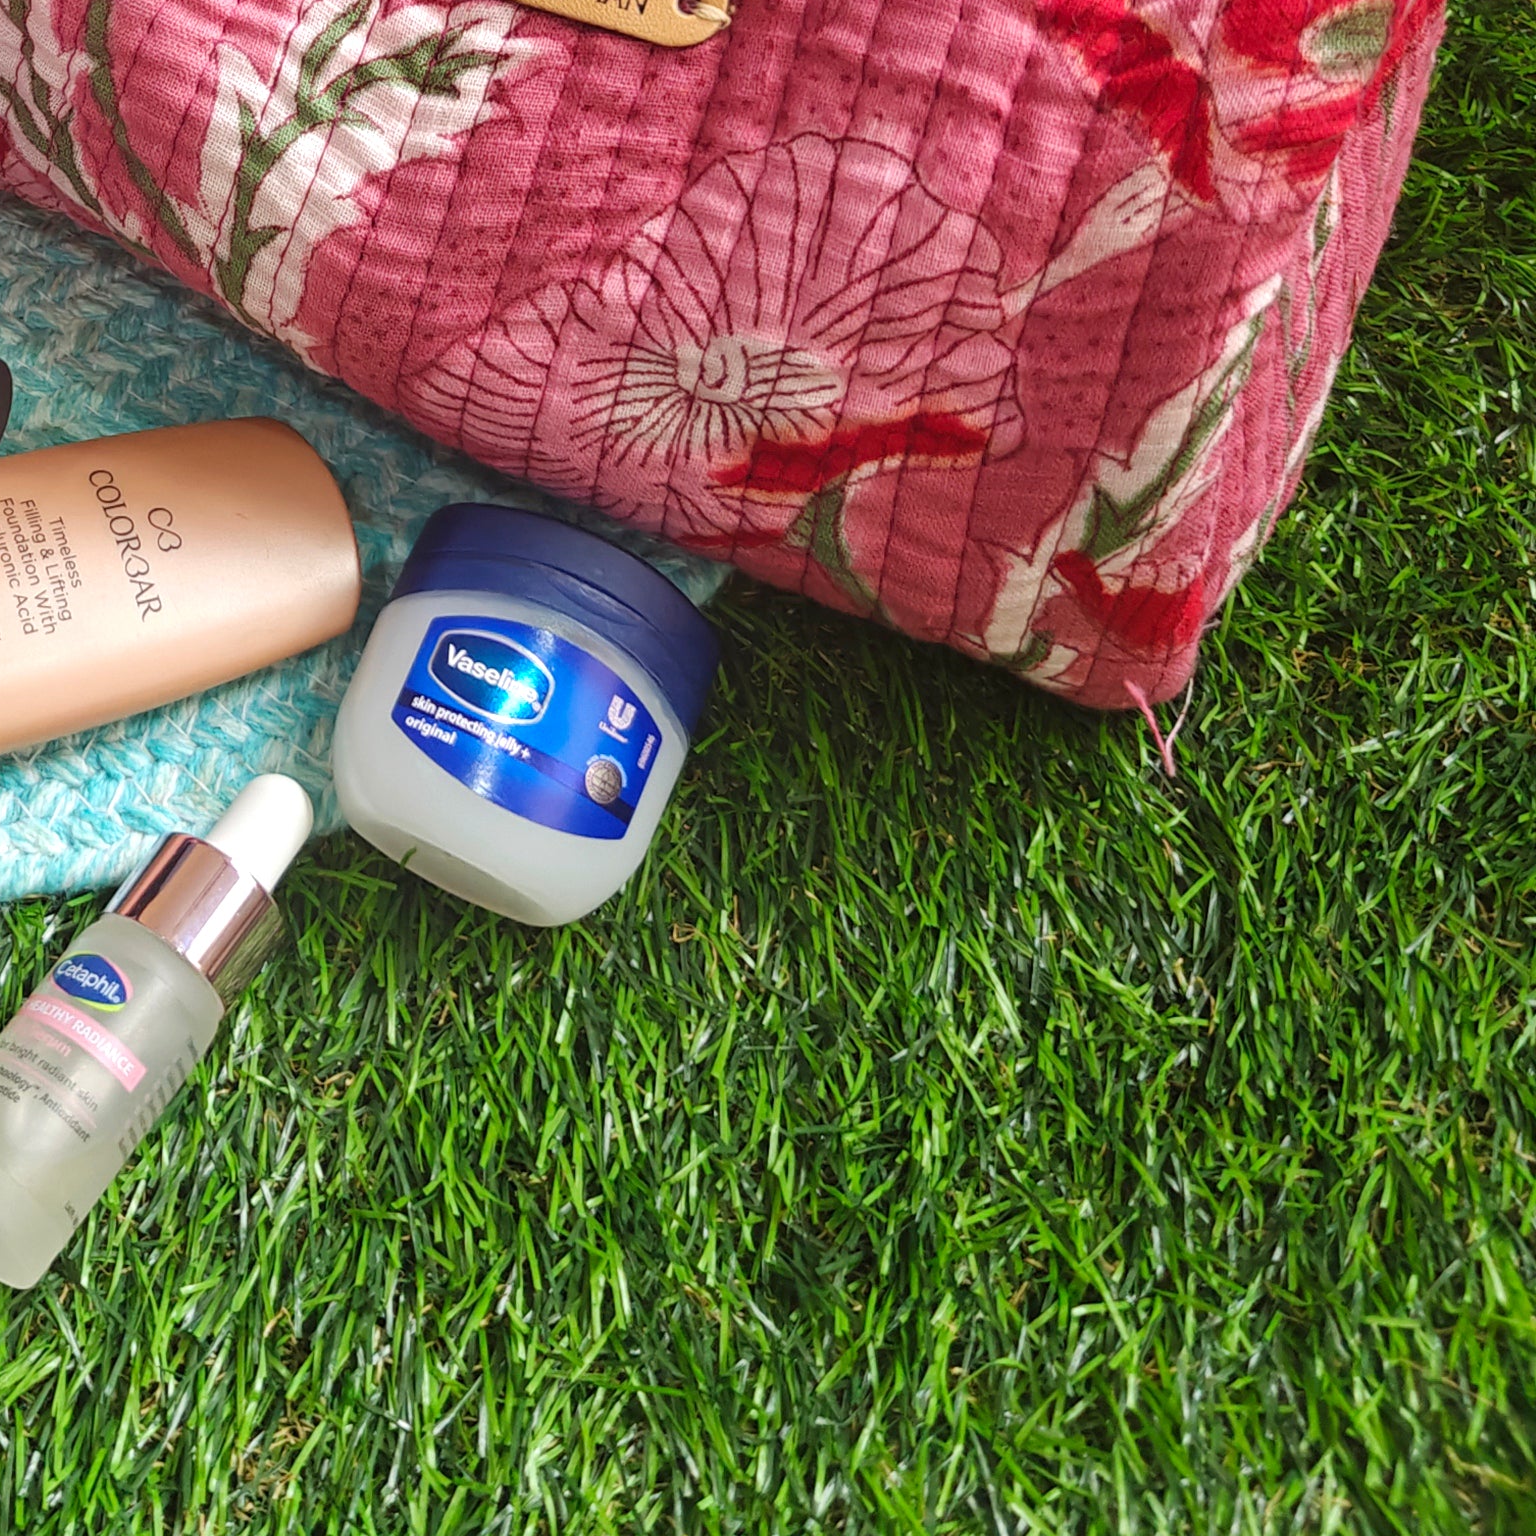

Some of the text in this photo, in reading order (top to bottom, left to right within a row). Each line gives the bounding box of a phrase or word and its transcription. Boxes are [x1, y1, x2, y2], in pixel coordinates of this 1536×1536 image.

[0, 497, 57, 636] Foundation With
[20, 498, 73, 622] Filling & Lifting
[48, 515, 83, 589] Timeless
[12, 593, 39, 636] Acid
[447, 643, 540, 704] Vaseline
[405, 715, 458, 747] original
[411, 695, 437, 715] skin
[434, 706, 497, 745] protecting
[56, 959, 121, 1002] Cetaphil
[72, 1019, 135, 1078] RADIANCE
[37, 1058, 77, 1091] radiant
[77, 1086, 99, 1114] skin
[38, 1092, 91, 1143] Antioxidant
